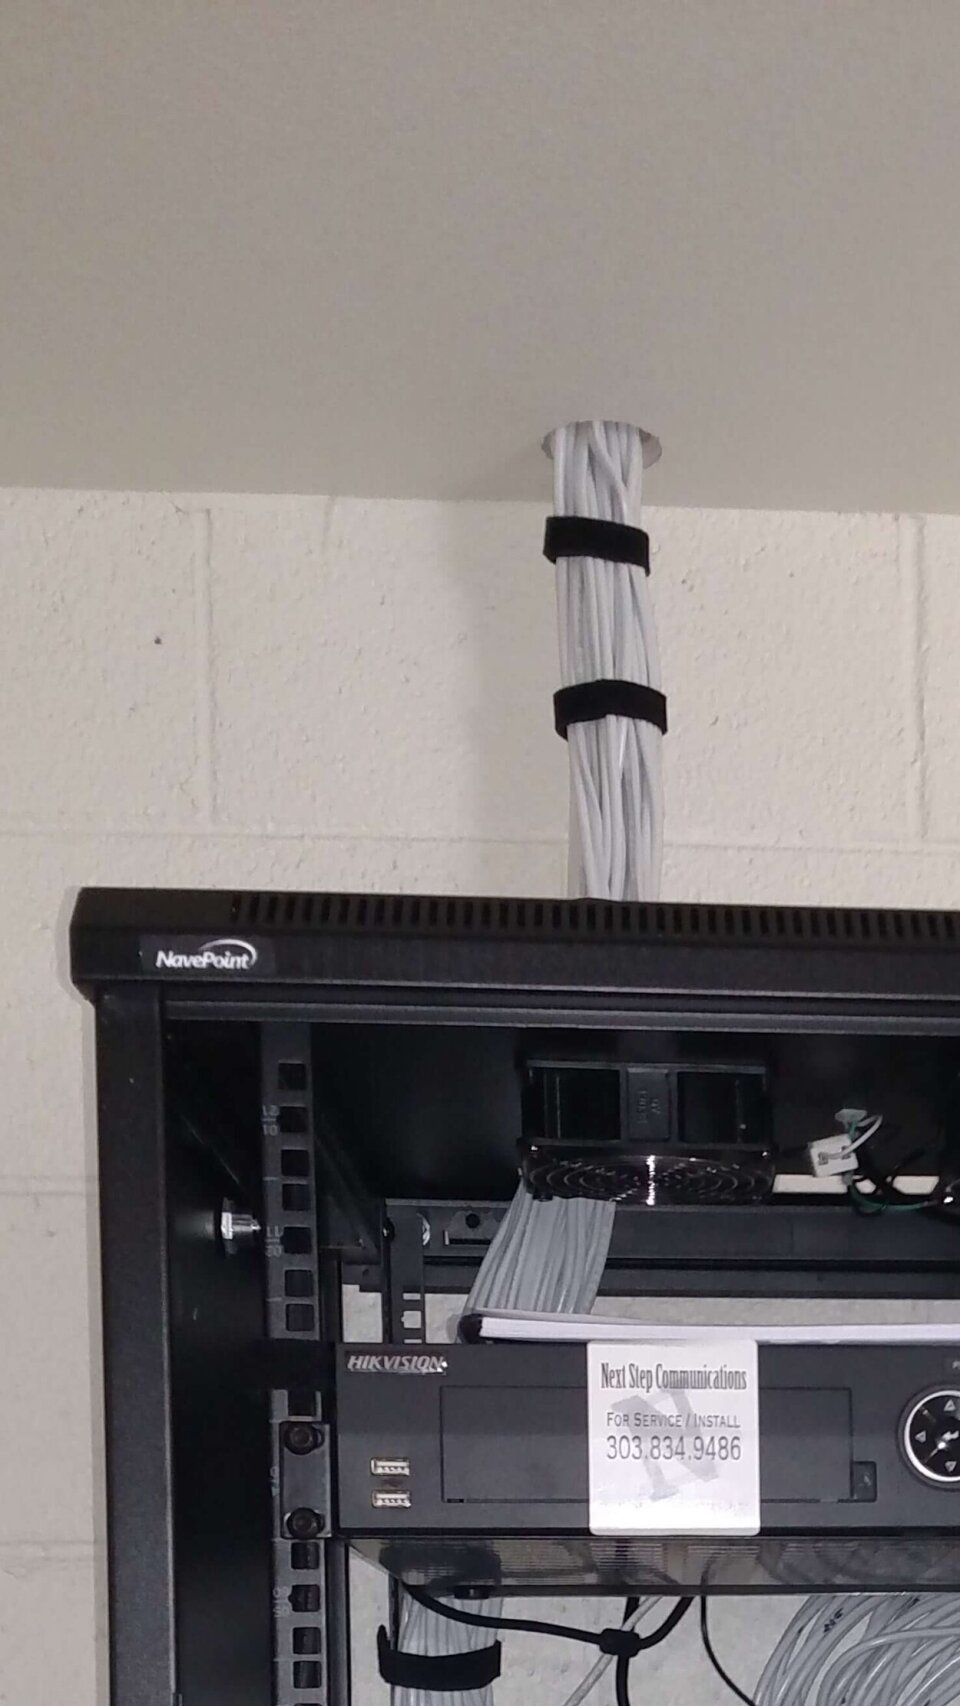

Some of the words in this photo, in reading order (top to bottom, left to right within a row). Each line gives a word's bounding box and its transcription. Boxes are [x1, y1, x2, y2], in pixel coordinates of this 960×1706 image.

[156, 950, 249, 969] NavePoint
[347, 1355, 444, 1371] HIKVISION
[601, 1362, 626, 1389] Next
[629, 1362, 653, 1393] Step
[655, 1363, 747, 1390] Communications
[607, 1412, 629, 1427] FOR
[634, 1412, 682, 1427] SERVICE
[694, 1413, 741, 1428] INSTALL
[606, 1434, 742, 1461] 303.834.9486
